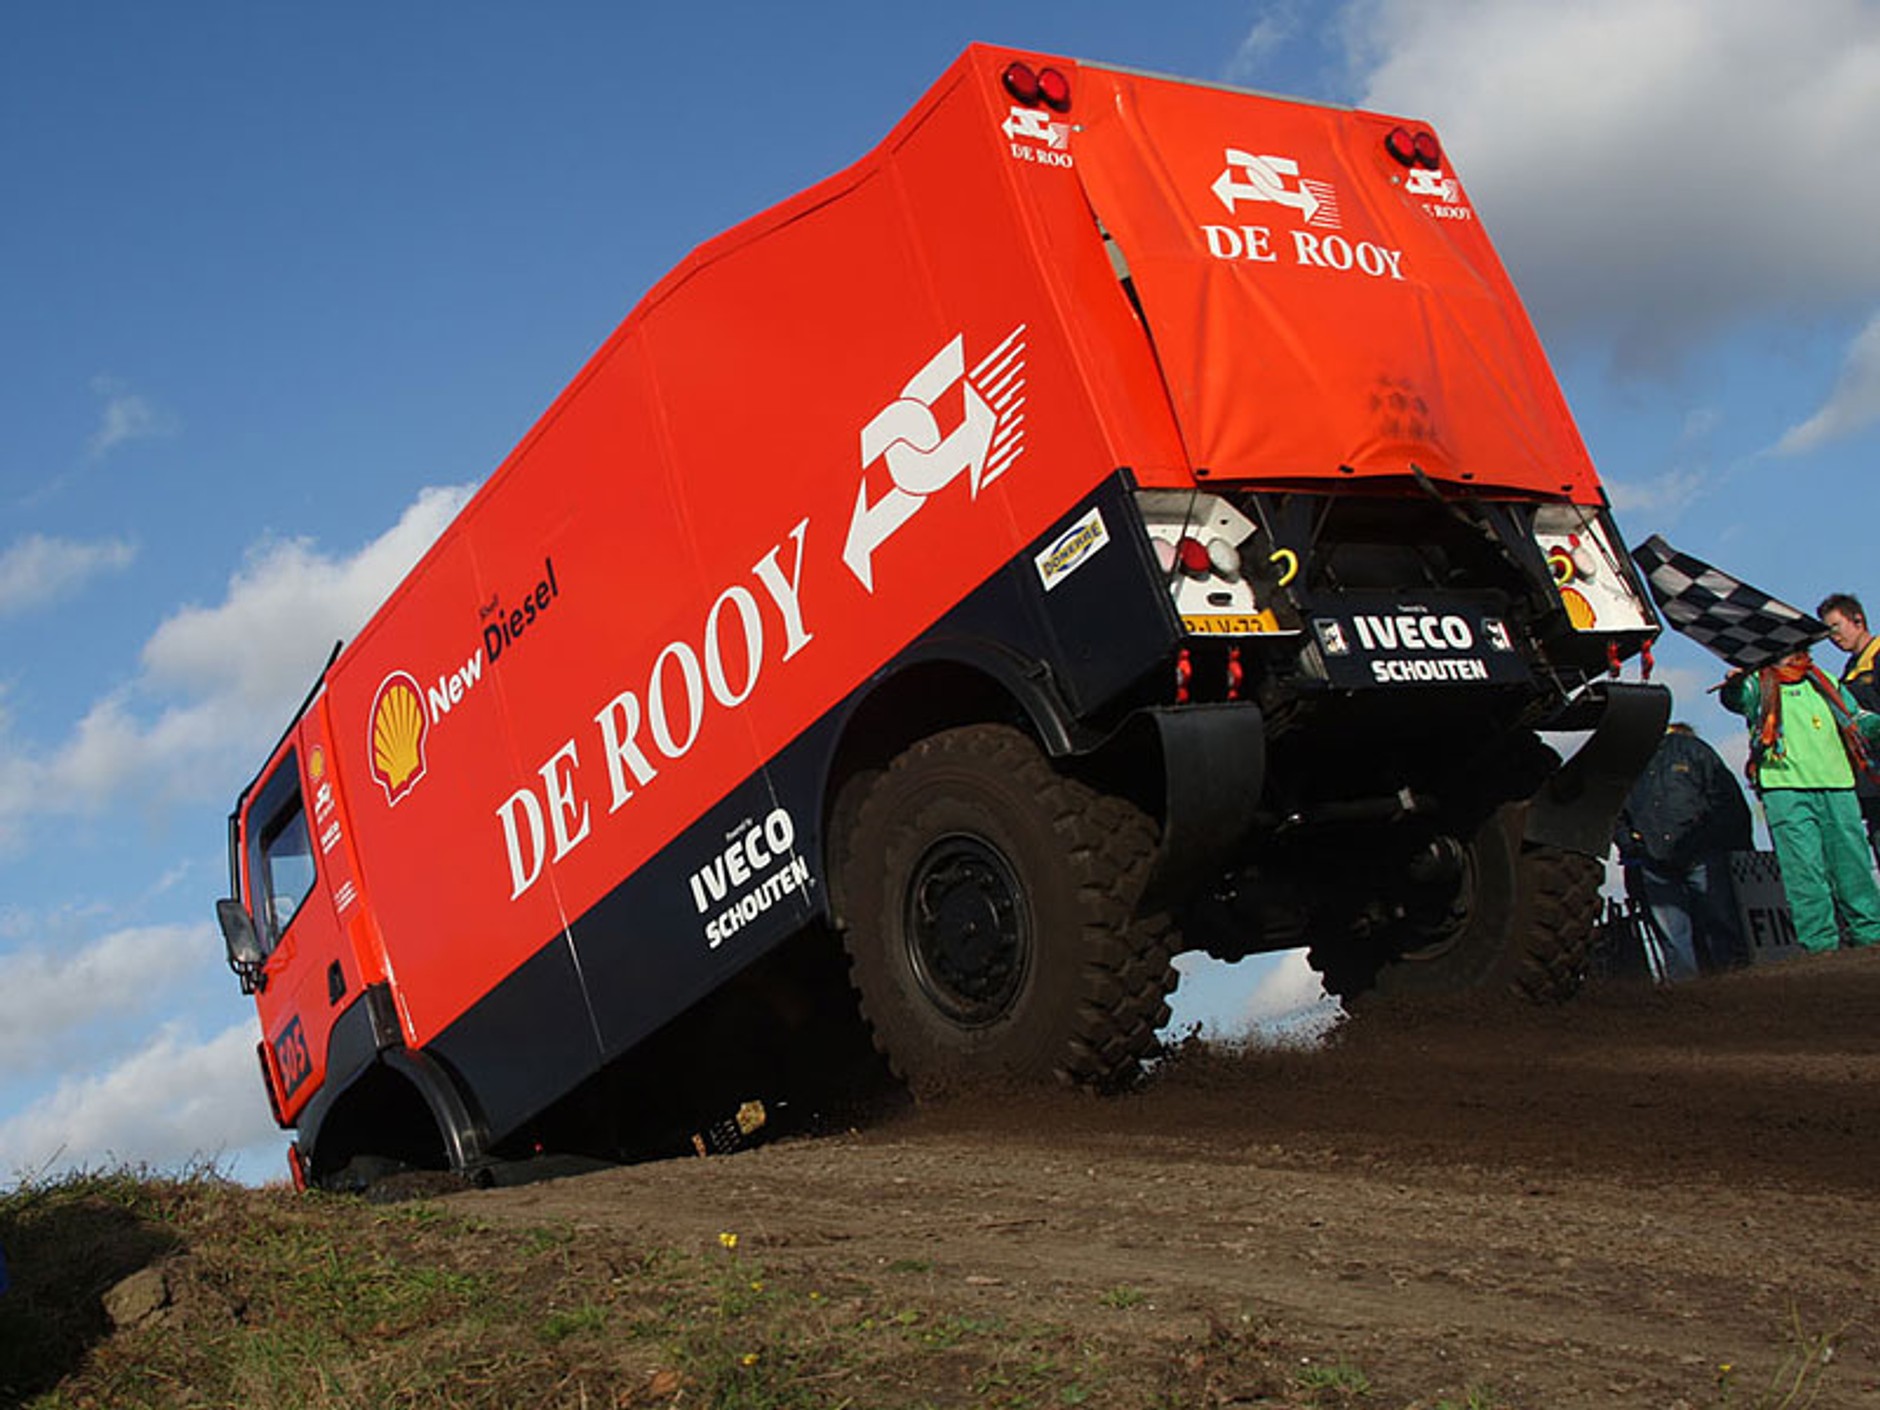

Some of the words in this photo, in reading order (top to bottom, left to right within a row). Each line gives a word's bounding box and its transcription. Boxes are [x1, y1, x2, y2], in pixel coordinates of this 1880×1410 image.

[1010, 143, 1035, 161] DE
[1036, 149, 1073, 168] ROO
[1201, 225, 1277, 262] DE
[1289, 230, 1405, 280] ROOY
[427, 648, 482, 725] New
[483, 556, 559, 664] Diesel
[1353, 615, 1473, 650] IVECO
[1371, 658, 1489, 683] SCHOUTEN
[496, 738, 592, 901] DE
[594, 517, 814, 815] ROOY
[690, 808, 795, 914] IVECO
[705, 855, 810, 950] SCHOUTEN
[1748, 906, 1798, 947] FIN
